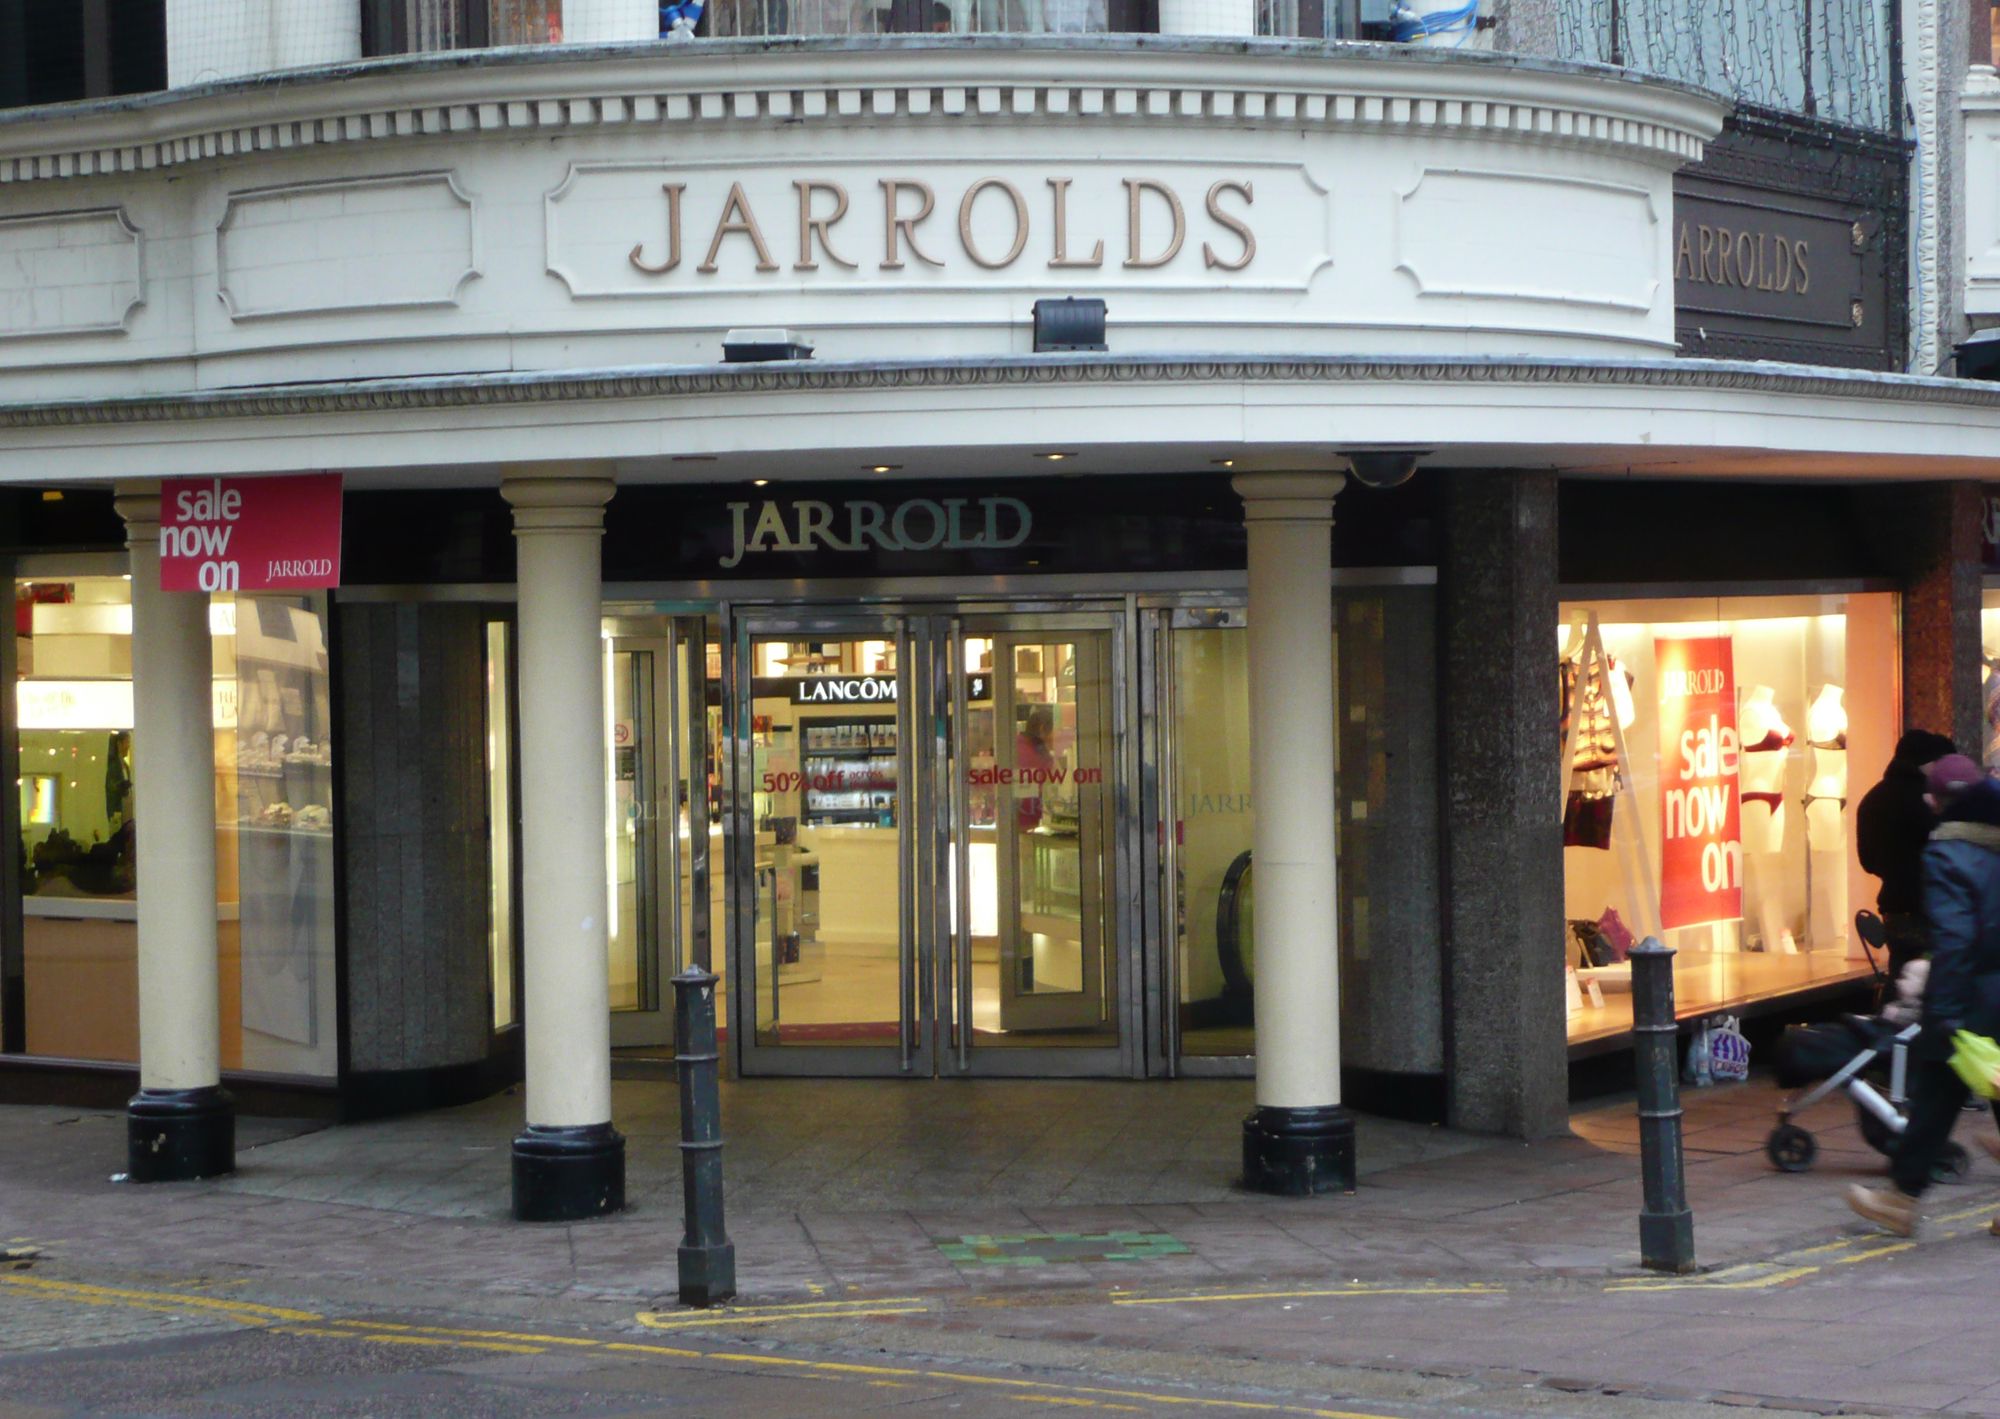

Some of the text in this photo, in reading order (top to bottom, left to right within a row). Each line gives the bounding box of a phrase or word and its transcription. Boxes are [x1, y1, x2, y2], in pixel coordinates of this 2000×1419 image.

[629, 177, 1258, 274] JARROLDS
[1675, 222, 1810, 295] ARROLDS
[176, 478, 241, 522] sale
[160, 525, 232, 557] now
[719, 497, 1033, 568] JARROLD
[199, 560, 240, 592] on
[266, 559, 332, 582] JARROLD
[800, 677, 897, 700] LANCÔM
[1680, 714, 1739, 780] sale
[763, 771, 810, 793] 50%
[813, 769, 846, 792] off
[968, 765, 1102, 785] sale now on
[1666, 784, 1729, 839] now
[1702, 839, 1742, 892] on
